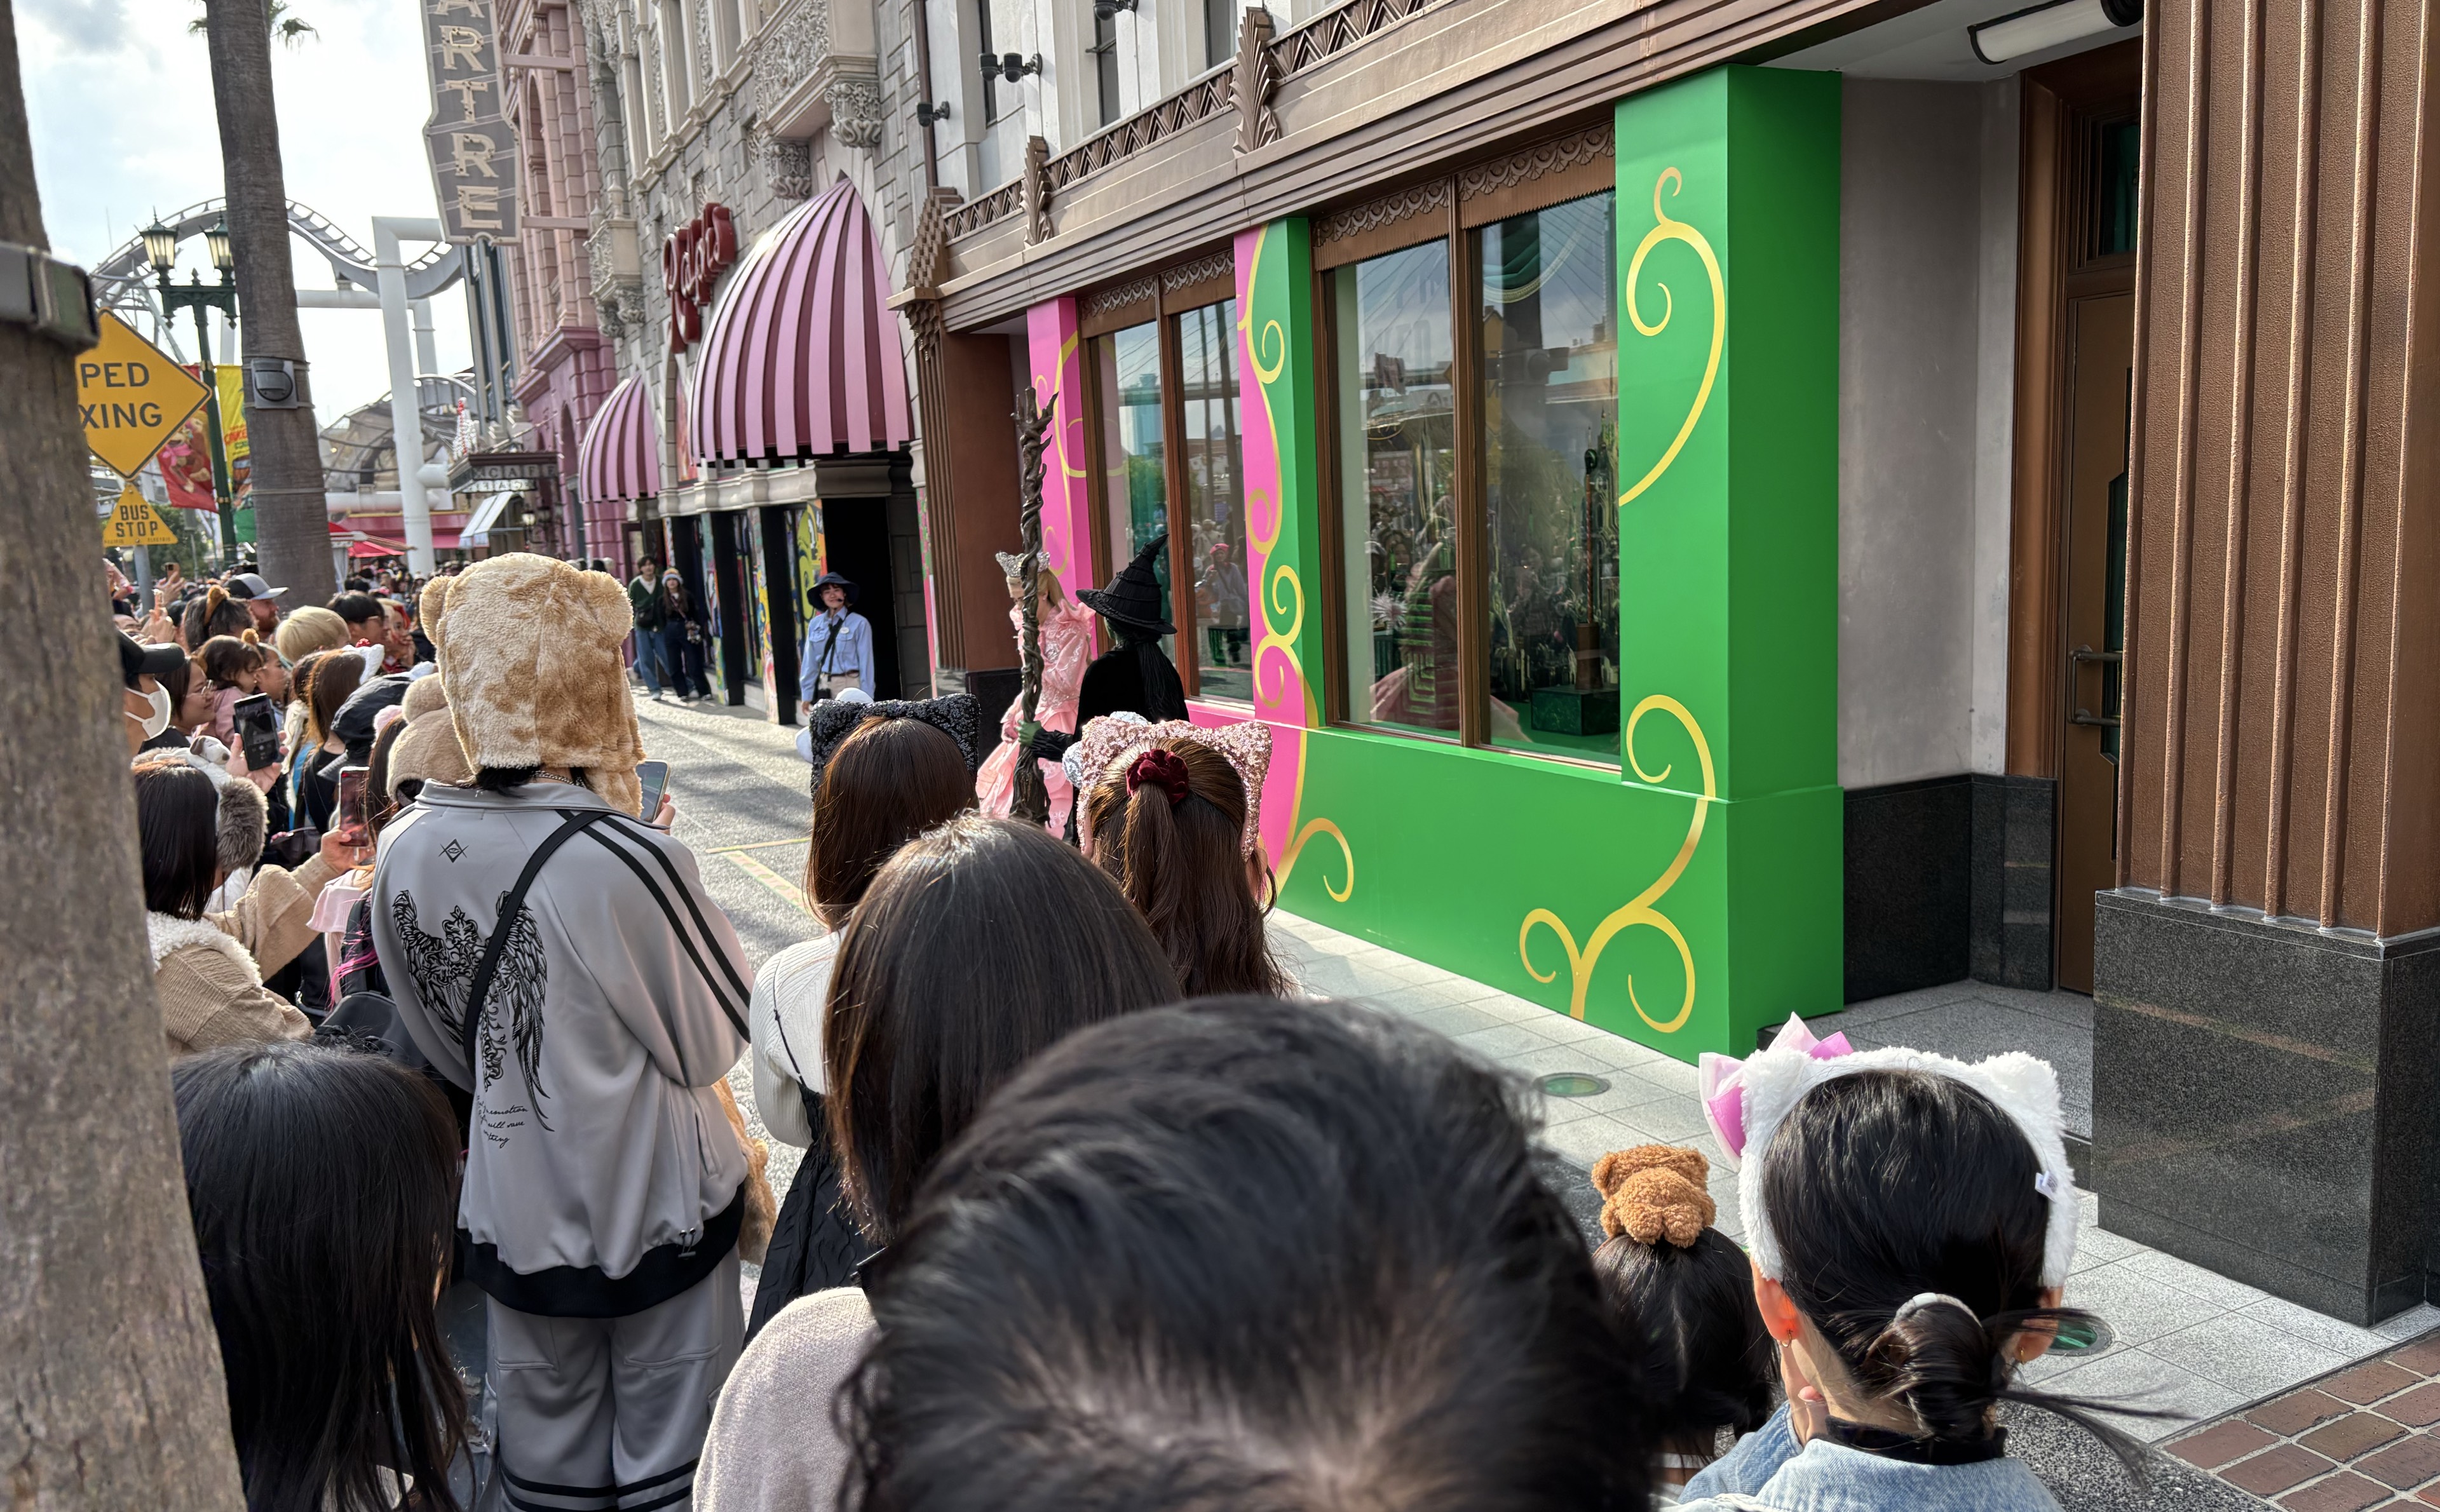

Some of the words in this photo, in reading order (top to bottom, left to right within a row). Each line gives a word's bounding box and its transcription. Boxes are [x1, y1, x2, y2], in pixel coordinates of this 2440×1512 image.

[80, 362, 150, 388] PED
[78, 402, 163, 429] XING
[119, 505, 149, 520] BUS
[116, 521, 158, 537] STOP
